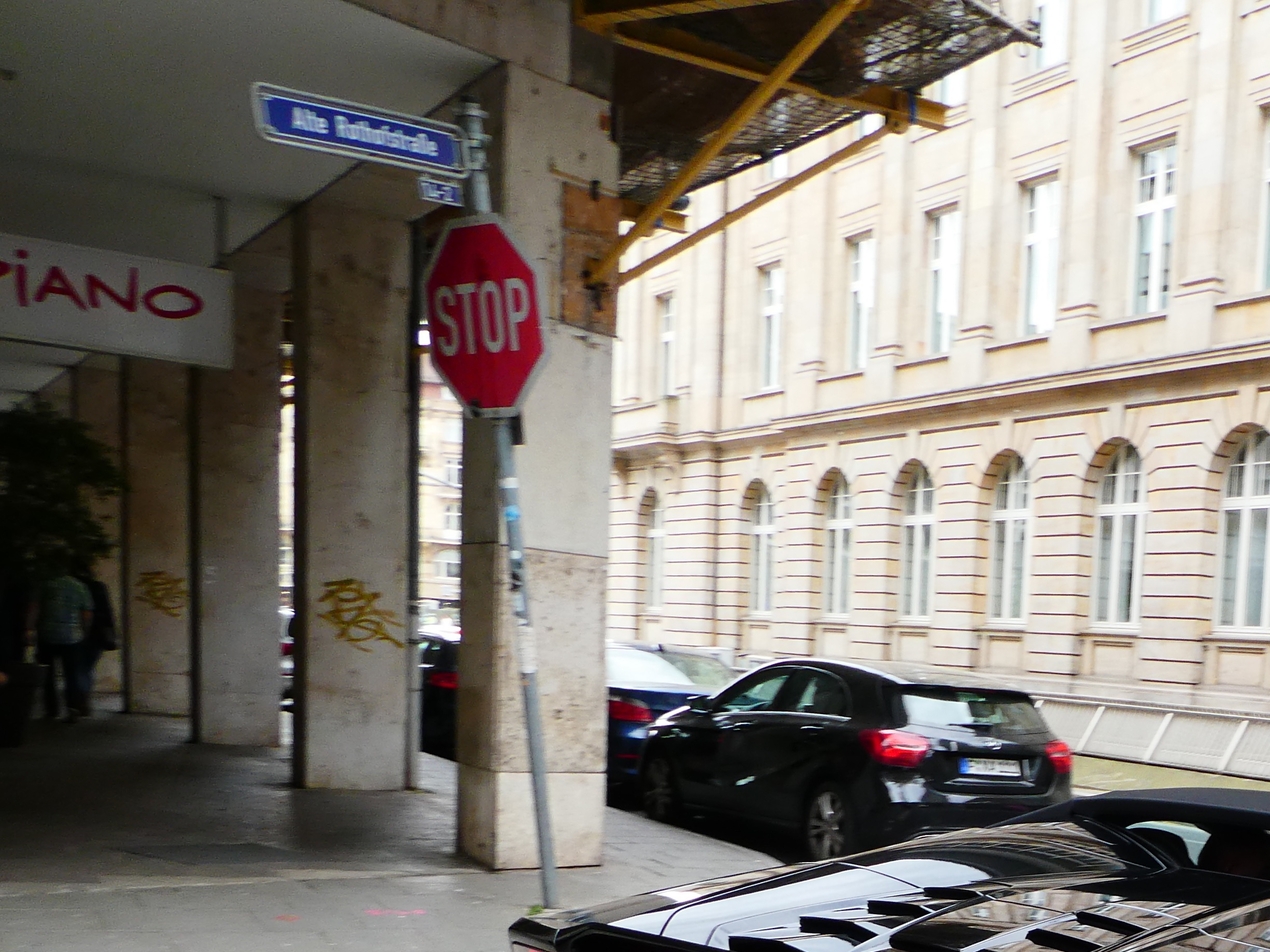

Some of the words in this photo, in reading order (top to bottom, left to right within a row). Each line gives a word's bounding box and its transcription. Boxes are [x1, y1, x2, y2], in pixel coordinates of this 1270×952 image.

[291, 106, 330, 134] Alte
[0, 249, 205, 319] iANO
[434, 278, 530, 356] STOP
